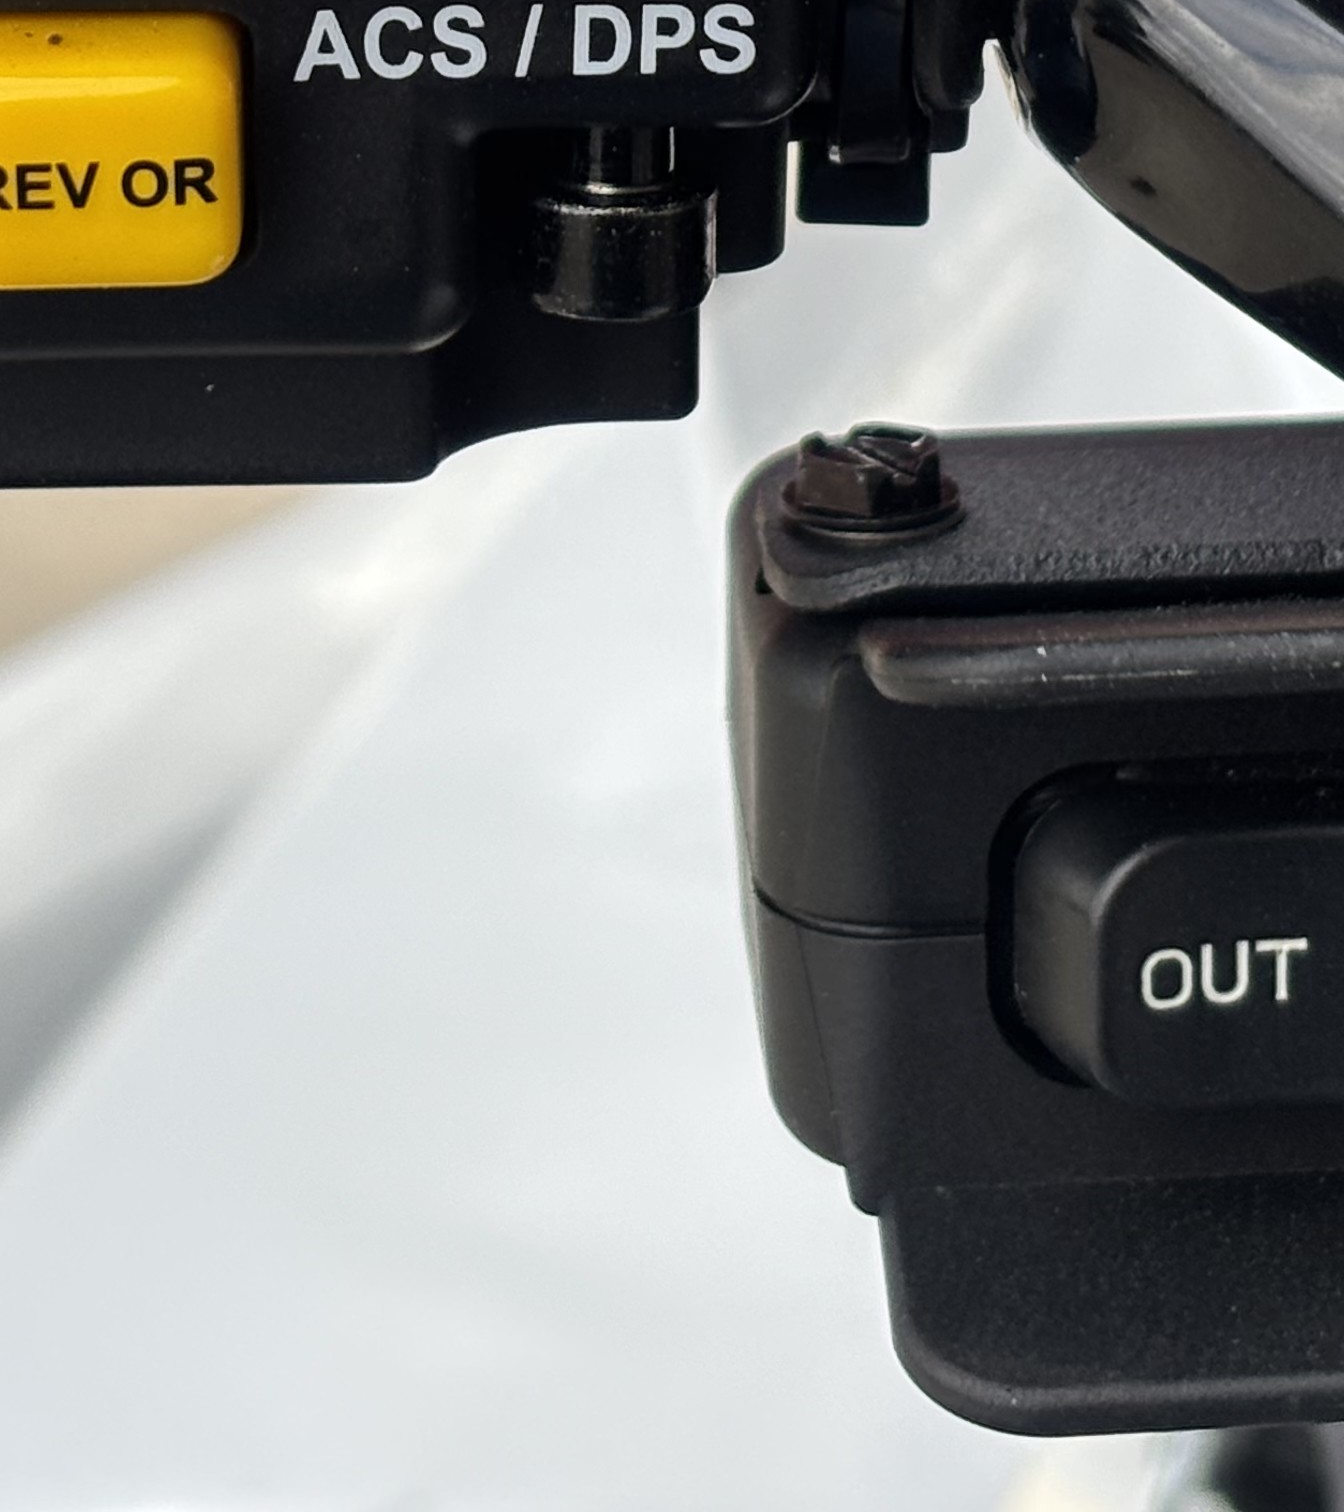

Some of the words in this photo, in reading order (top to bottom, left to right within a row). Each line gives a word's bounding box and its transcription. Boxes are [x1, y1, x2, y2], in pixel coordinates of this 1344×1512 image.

[294, 5, 486, 81] ACS
[515, 4, 543, 77] /
[573, 4, 755, 75] DPS
[122, 158, 218, 207] OR
[1142, 938, 1308, 1010] OUT
